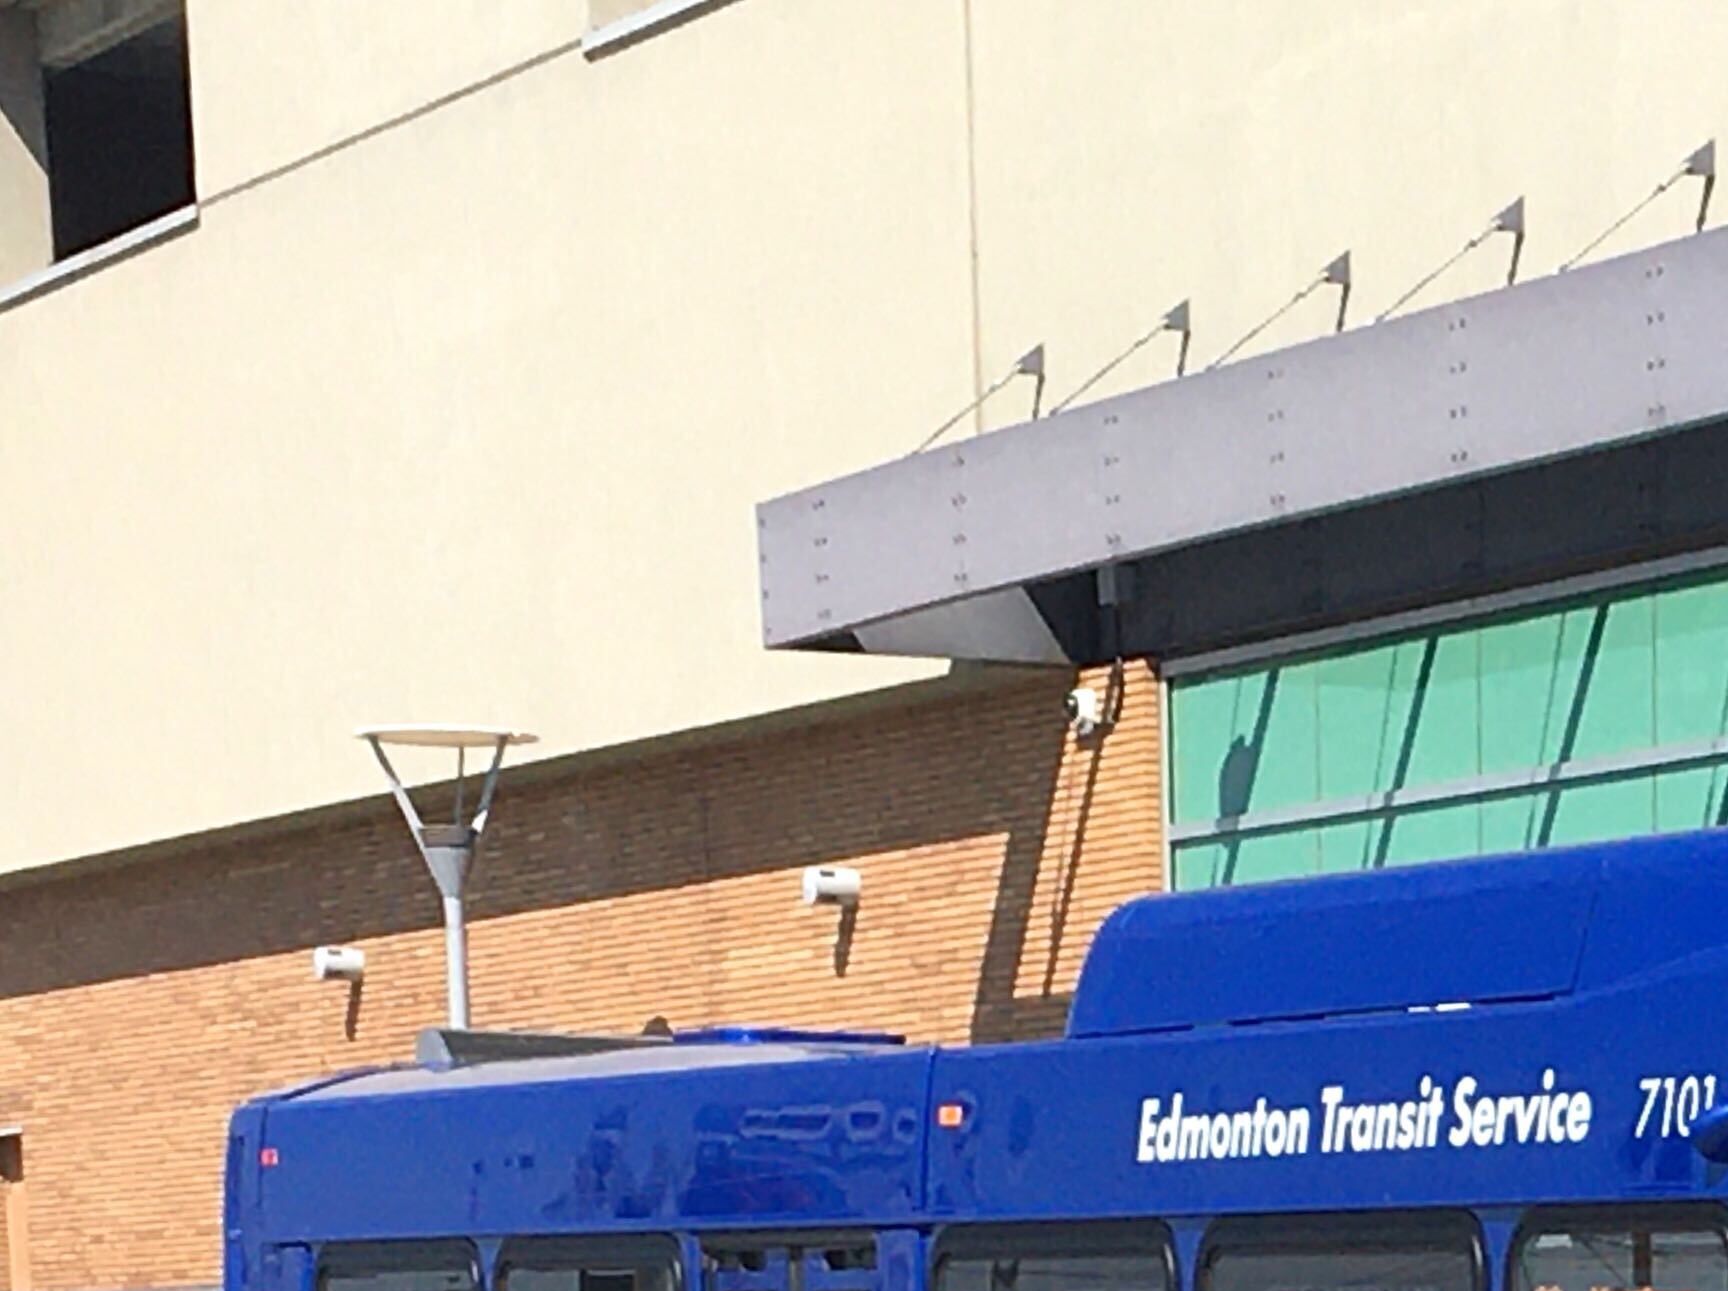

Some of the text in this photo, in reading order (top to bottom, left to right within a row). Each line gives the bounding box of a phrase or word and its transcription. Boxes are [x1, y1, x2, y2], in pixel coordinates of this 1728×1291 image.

[1136, 1068, 1592, 1164] Edmonton Transit Service
